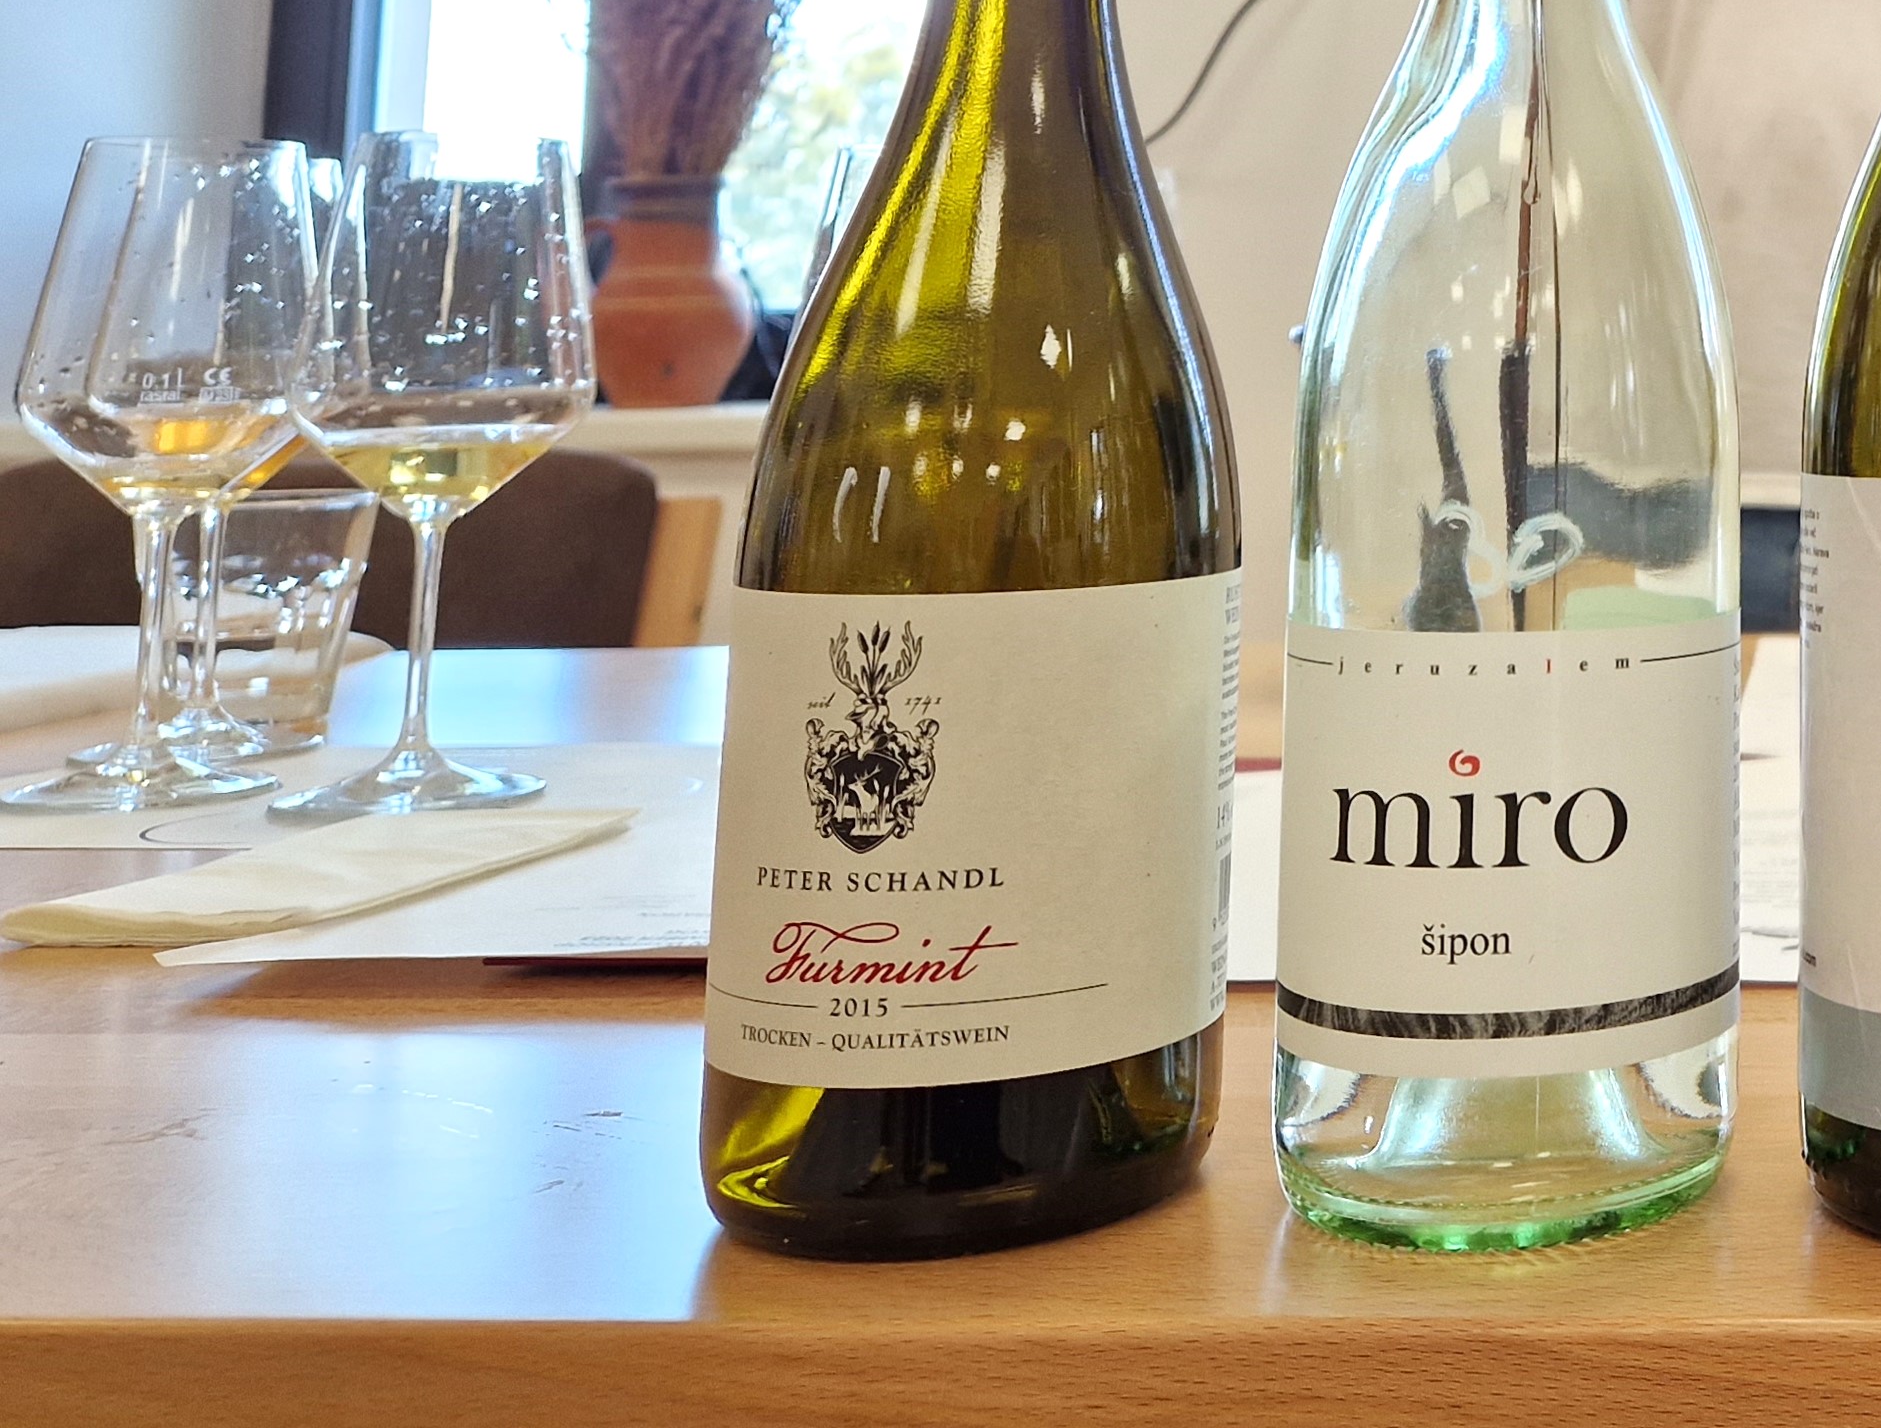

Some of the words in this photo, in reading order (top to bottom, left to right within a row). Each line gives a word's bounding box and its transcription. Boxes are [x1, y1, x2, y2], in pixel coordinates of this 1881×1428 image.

[1337, 656, 1631, 676] jeruzalem
[904, 695, 942, 717] 1741
[1329, 748, 1629, 869] miro
[757, 866, 833, 892] PETER
[846, 867, 1004, 893] SCHANDL
[764, 921, 1018, 987] Furmint
[1421, 923, 1511, 965] šipon
[829, 997, 888, 1018] 2015
[741, 1024, 812, 1048] TROCKEN
[831, 1025, 1010, 1053] QUALITÄTSWEIN
